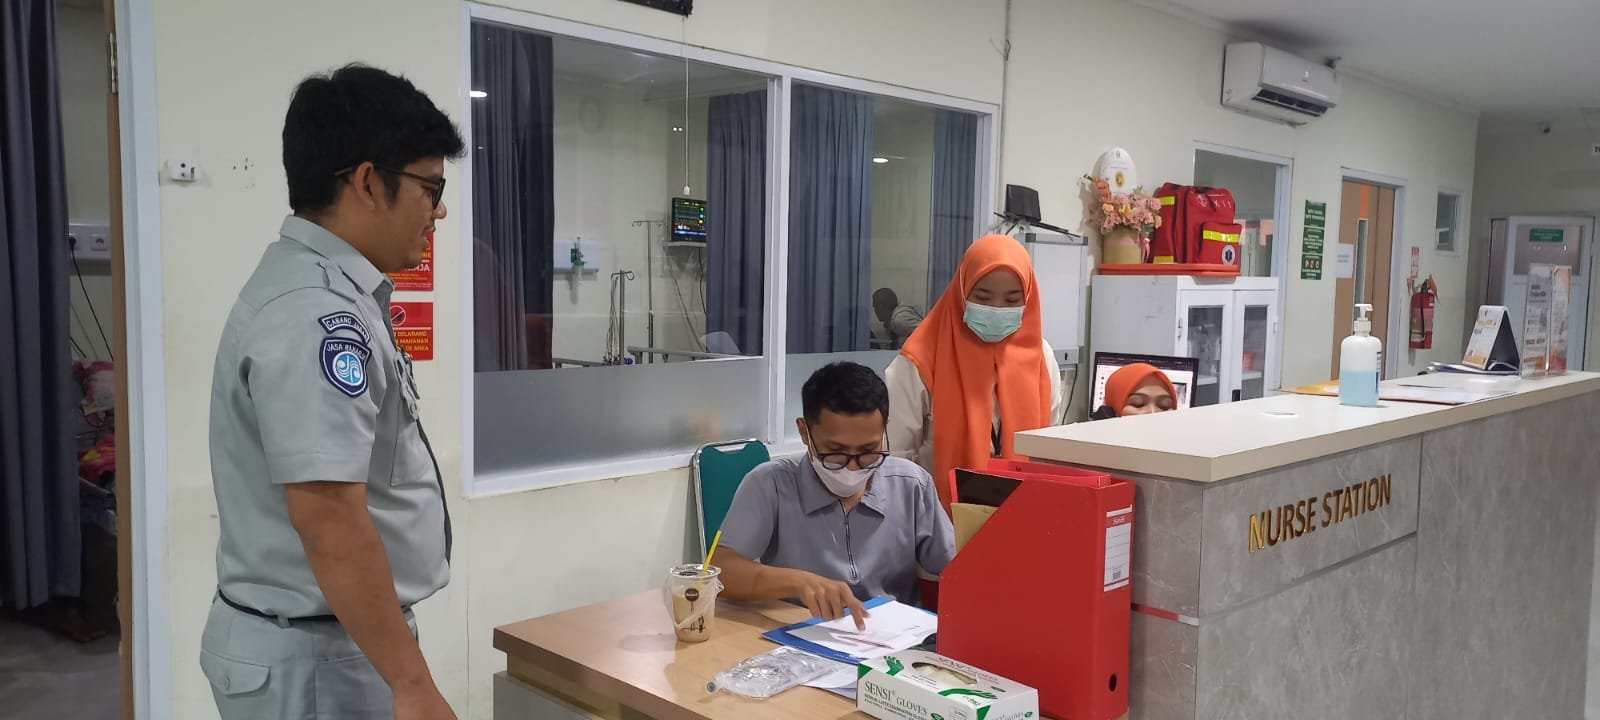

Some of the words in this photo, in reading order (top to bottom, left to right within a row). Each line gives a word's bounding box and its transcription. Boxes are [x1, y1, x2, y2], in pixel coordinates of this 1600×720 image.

[327, 343, 343, 352] JASA
[1249, 497, 1317, 553] NURSE
[1321, 473, 1391, 528] STATION
[896, 696, 928, 715] GLOVES
